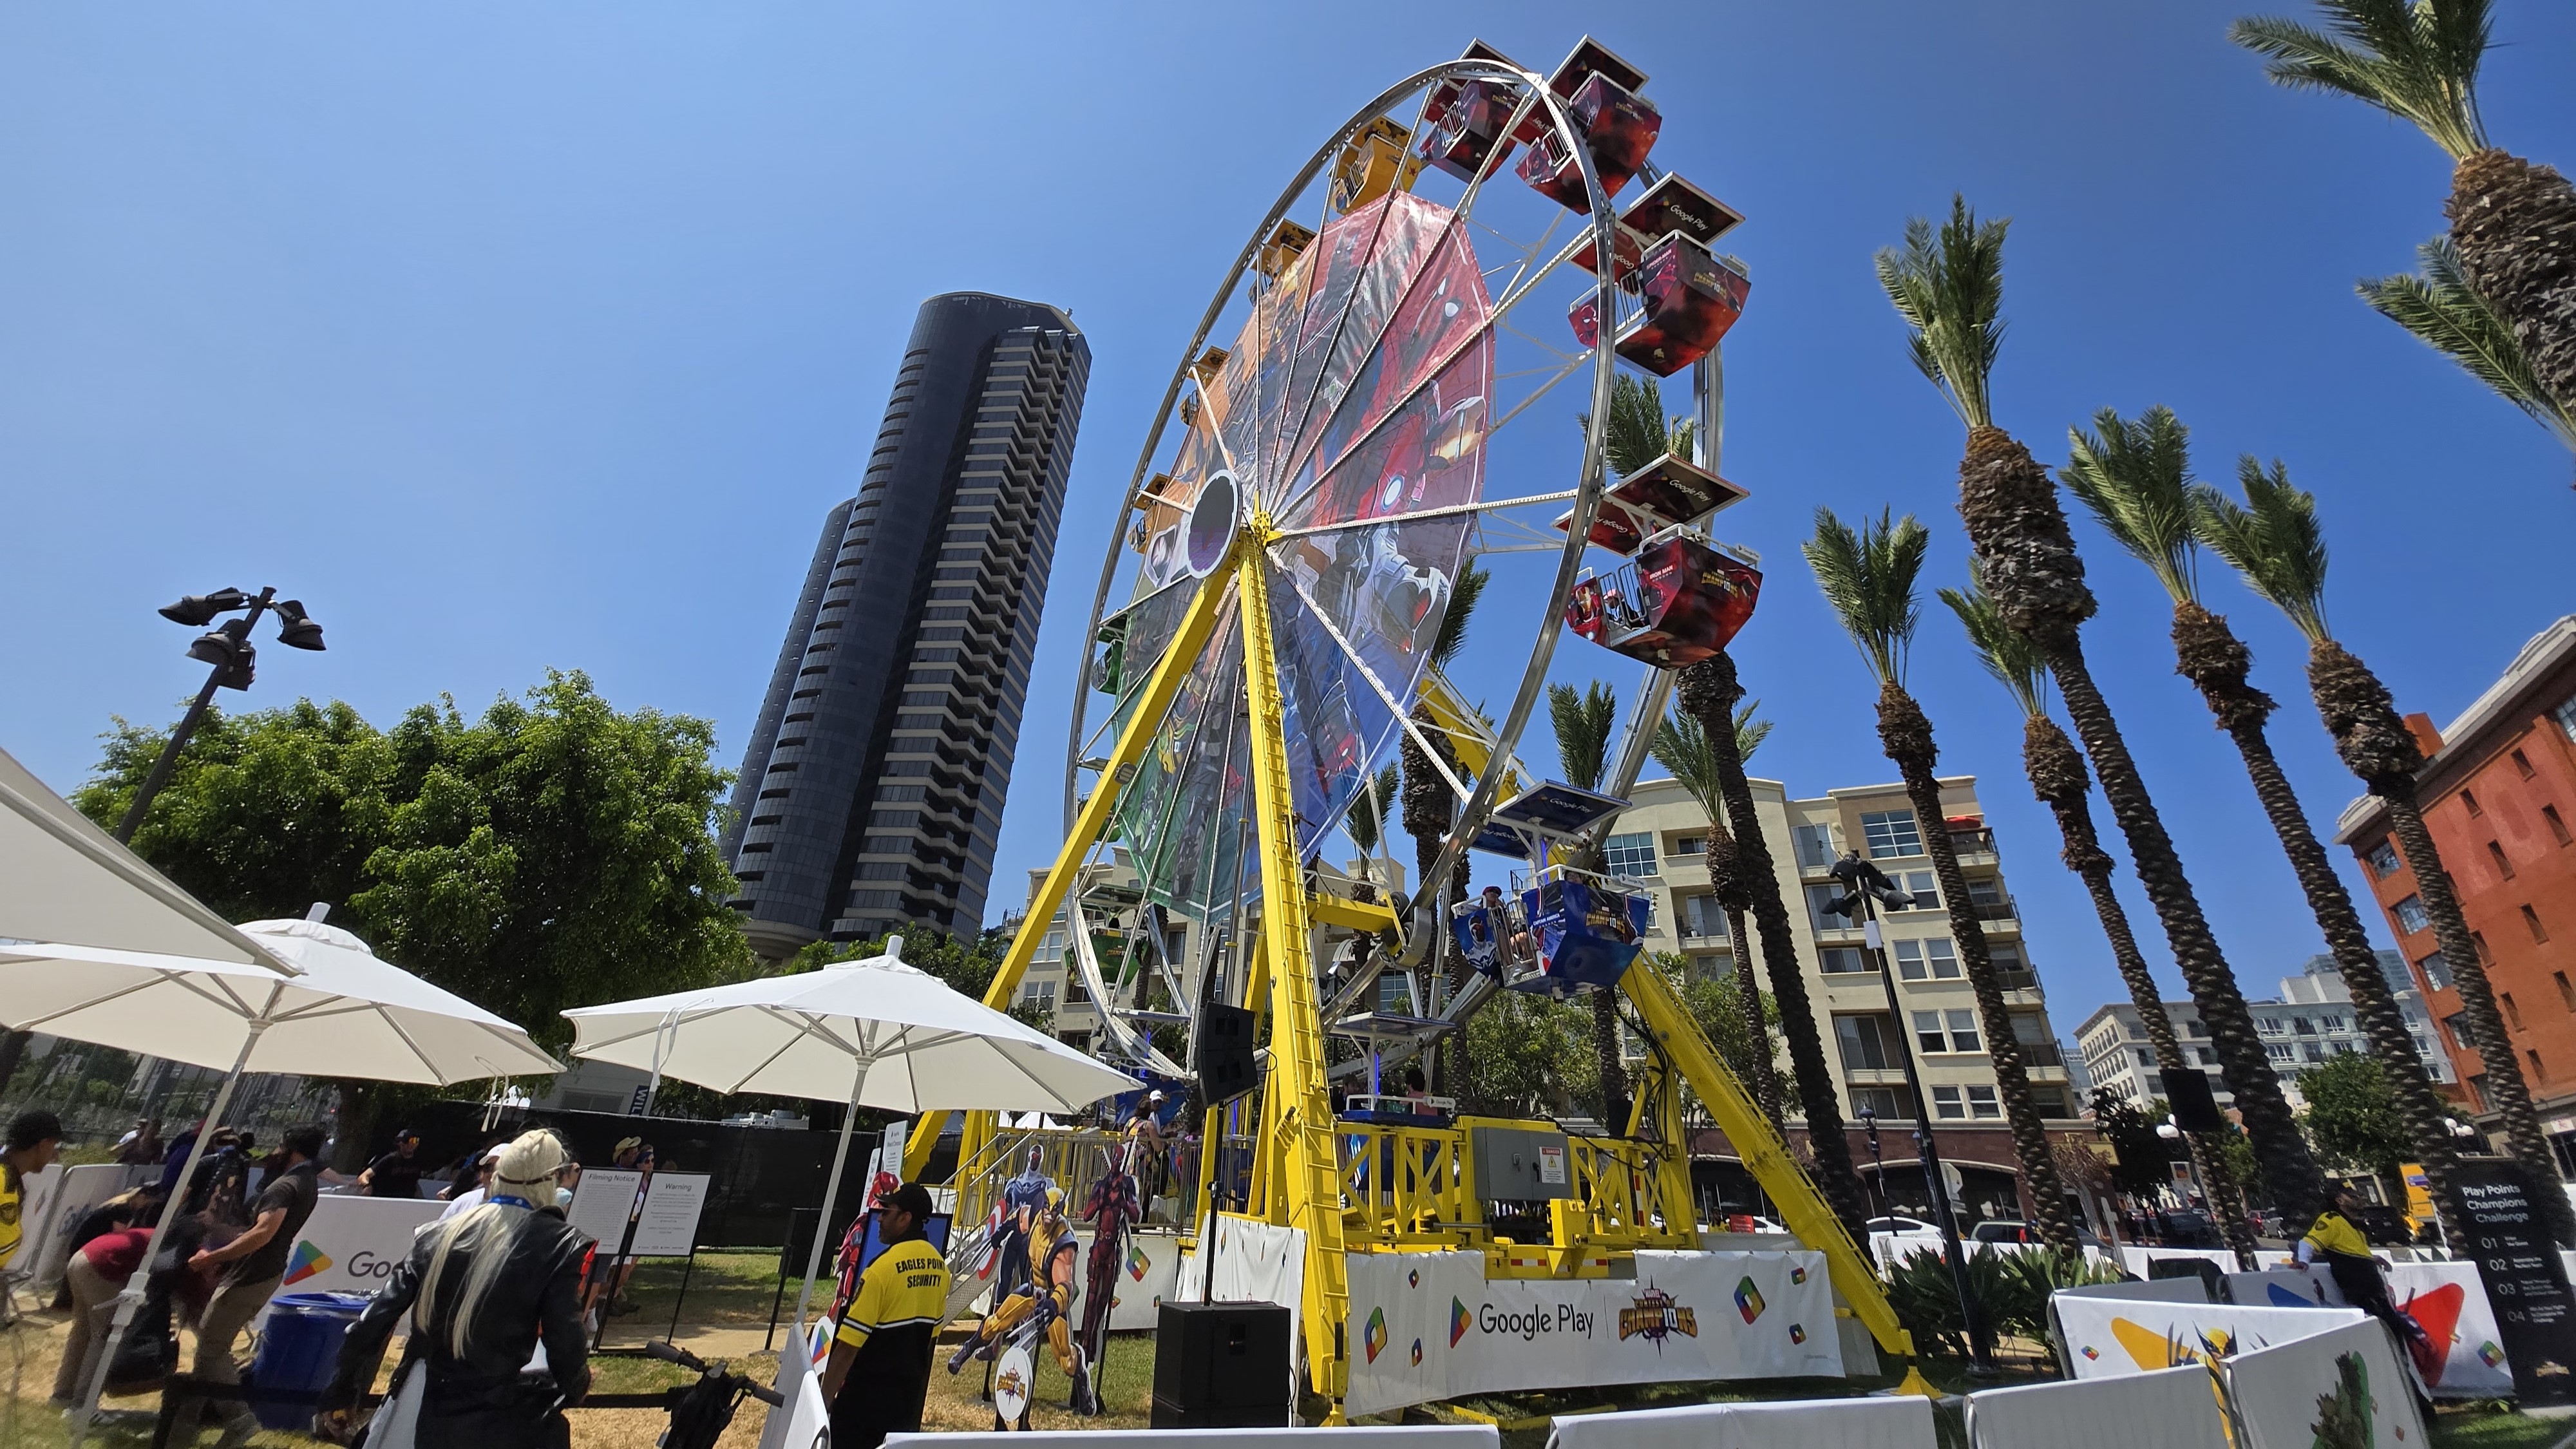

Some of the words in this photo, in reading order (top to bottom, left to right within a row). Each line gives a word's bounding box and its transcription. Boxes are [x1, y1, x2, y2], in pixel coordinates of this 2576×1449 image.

[1670, 204, 1694, 222] Google
[1692, 218, 1709, 231] Play
[1669, 479, 1696, 495] Google
[1694, 491, 1711, 502] Play
[1602, 520, 1628, 533] Google
[1649, 570, 1662, 580] IRON
[1662, 564, 1673, 574] MAN
[1549, 798, 1577, 809] Google
[1576, 805, 1593, 813] Play
[1493, 831, 1520, 841] Google
[1533, 917, 1546, 926] CAPTAIN
[1546, 913, 1560, 922] AMERICA
[588, 1173, 612, 1182] Filming
[665, 1183, 692, 1191] Warning
[2462, 1186, 2485, 1198] Play
[2486, 1184, 2521, 1195] Points
[2467, 1198, 2528, 1210] Champions
[2475, 1212, 2529, 1223] Challenge
[2481, 1237, 2498, 1249] 01
[895, 1258, 925, 1274] EAGLES
[927, 1258, 945, 1272] POINT
[2489, 1258, 2508, 1271] 02
[907, 1274, 942, 1289] SECURITY
[1645, 1289, 1661, 1298] MARVEL
[2498, 1283, 2516, 1295] 03
[1479, 1303, 1552, 1341] Google
[1558, 1303, 1594, 1340] Play
[2507, 1311, 2525, 1322] 04
